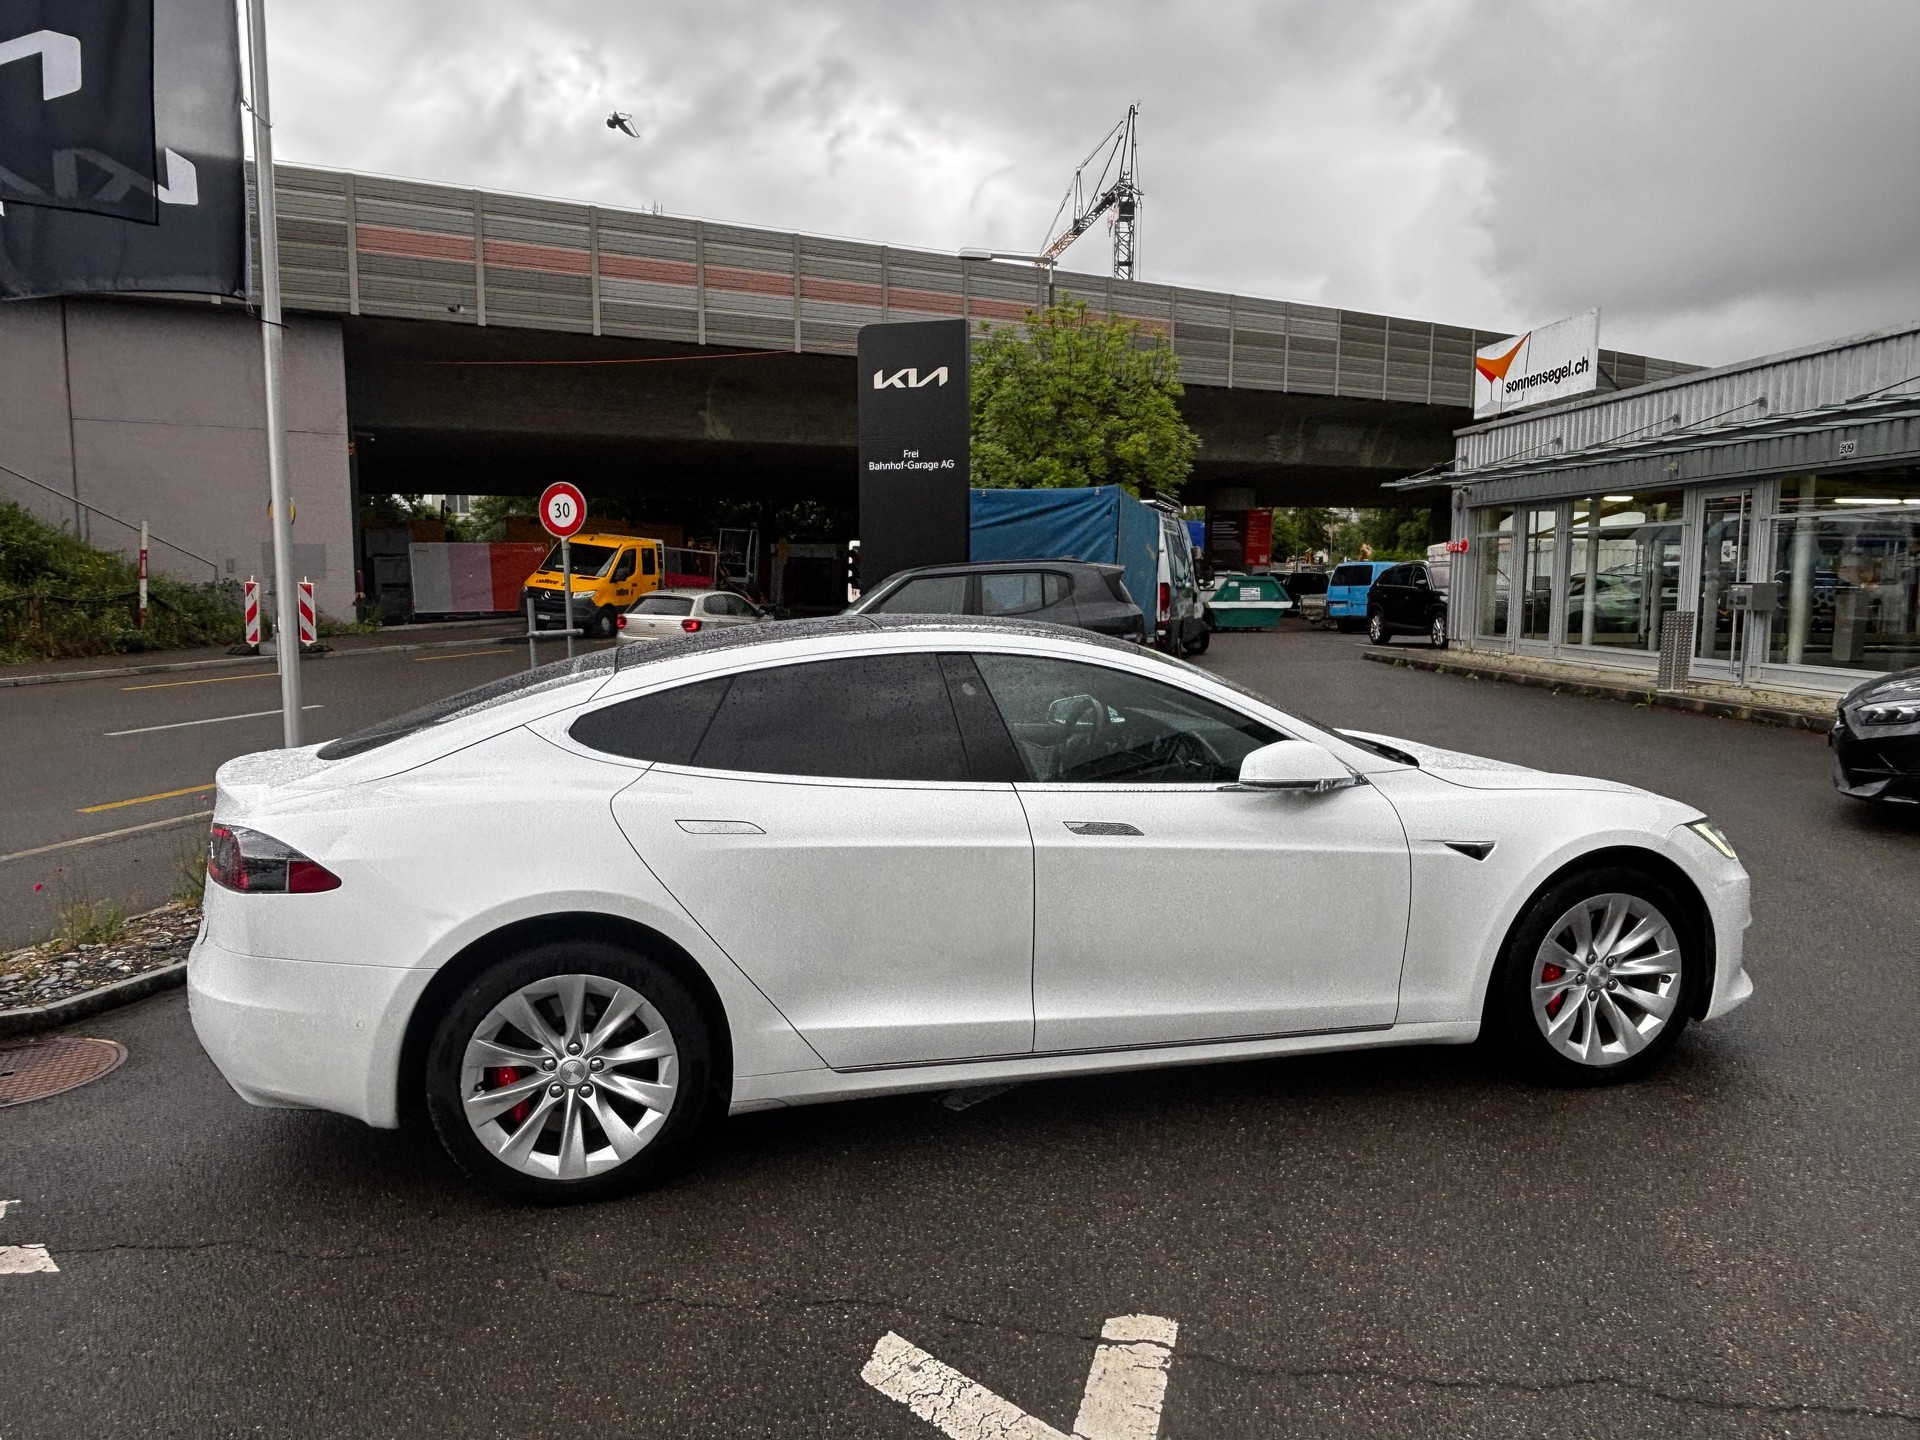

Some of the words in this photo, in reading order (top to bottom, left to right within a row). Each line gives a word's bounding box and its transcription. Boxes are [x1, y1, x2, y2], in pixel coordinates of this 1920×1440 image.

[873, 366, 949, 390] KIA
[1505, 356, 1589, 394] sonnensegel.ch
[903, 449, 919, 458] Frei
[1839, 442, 1855, 455] 209
[868, 460, 939, 471] Bahnhof-Garage
[940, 459, 955, 469] AG
[554, 502, 570, 519] 30
